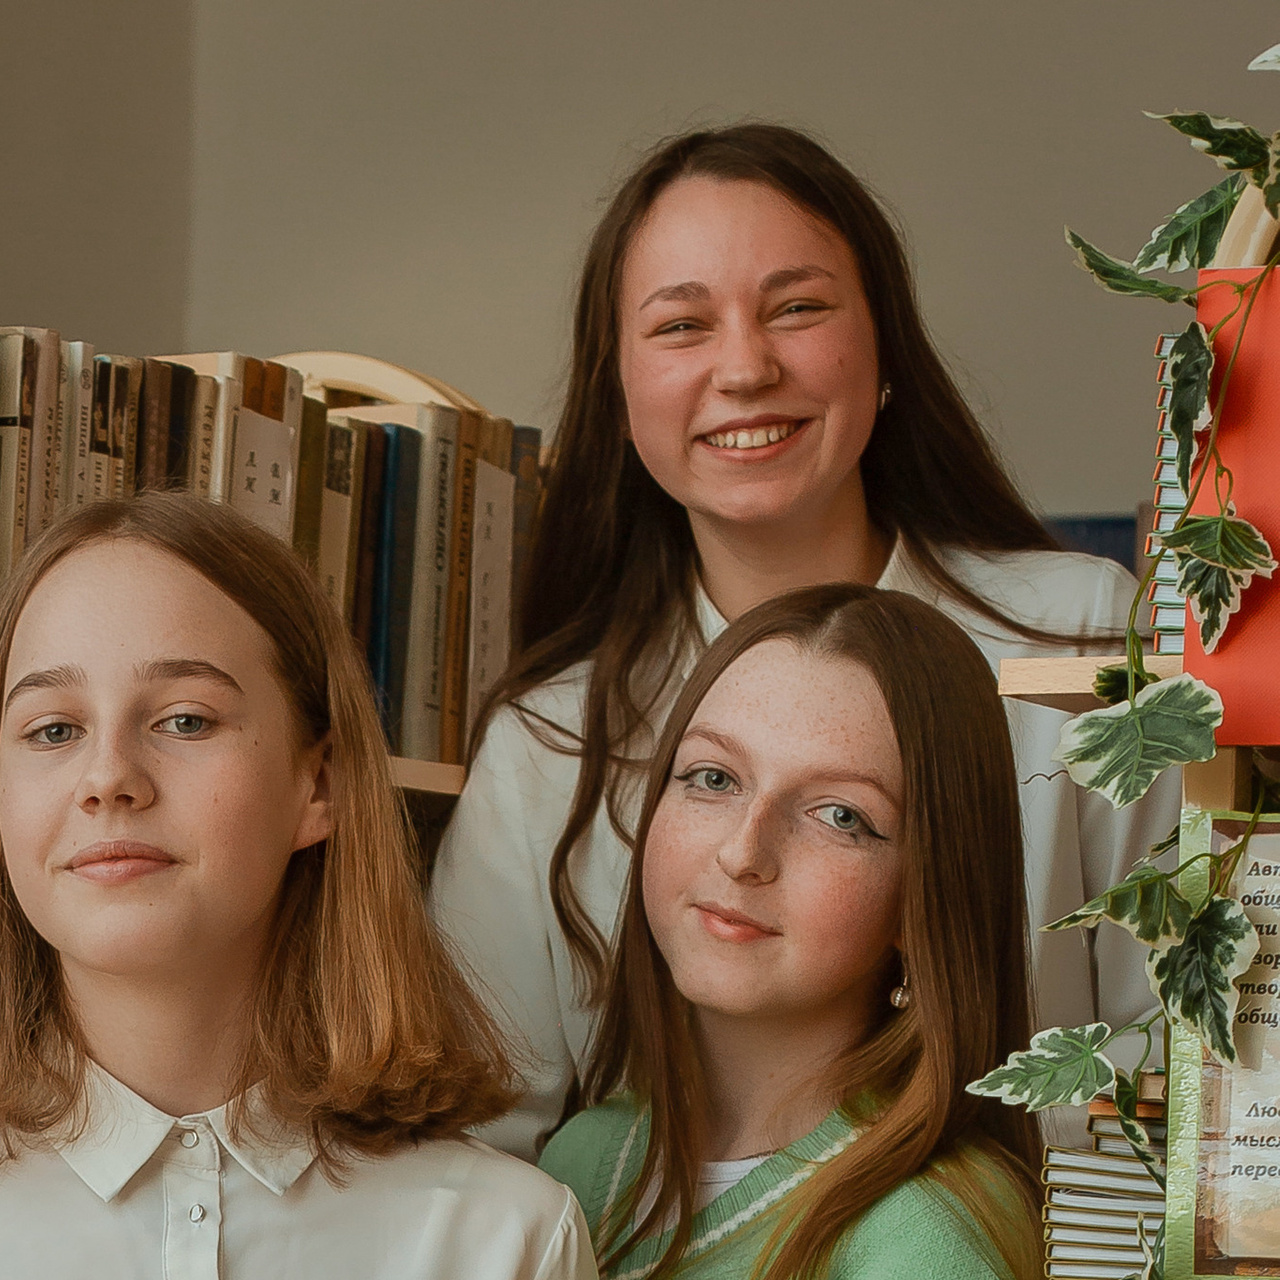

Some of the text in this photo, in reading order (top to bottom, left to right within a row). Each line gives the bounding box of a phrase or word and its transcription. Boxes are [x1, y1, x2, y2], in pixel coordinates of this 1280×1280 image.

[1245, 1101, 1280, 1118] Лю
[1230, 1134, 1280, 1148] мыс
[1230, 1163, 1280, 1181] пере
